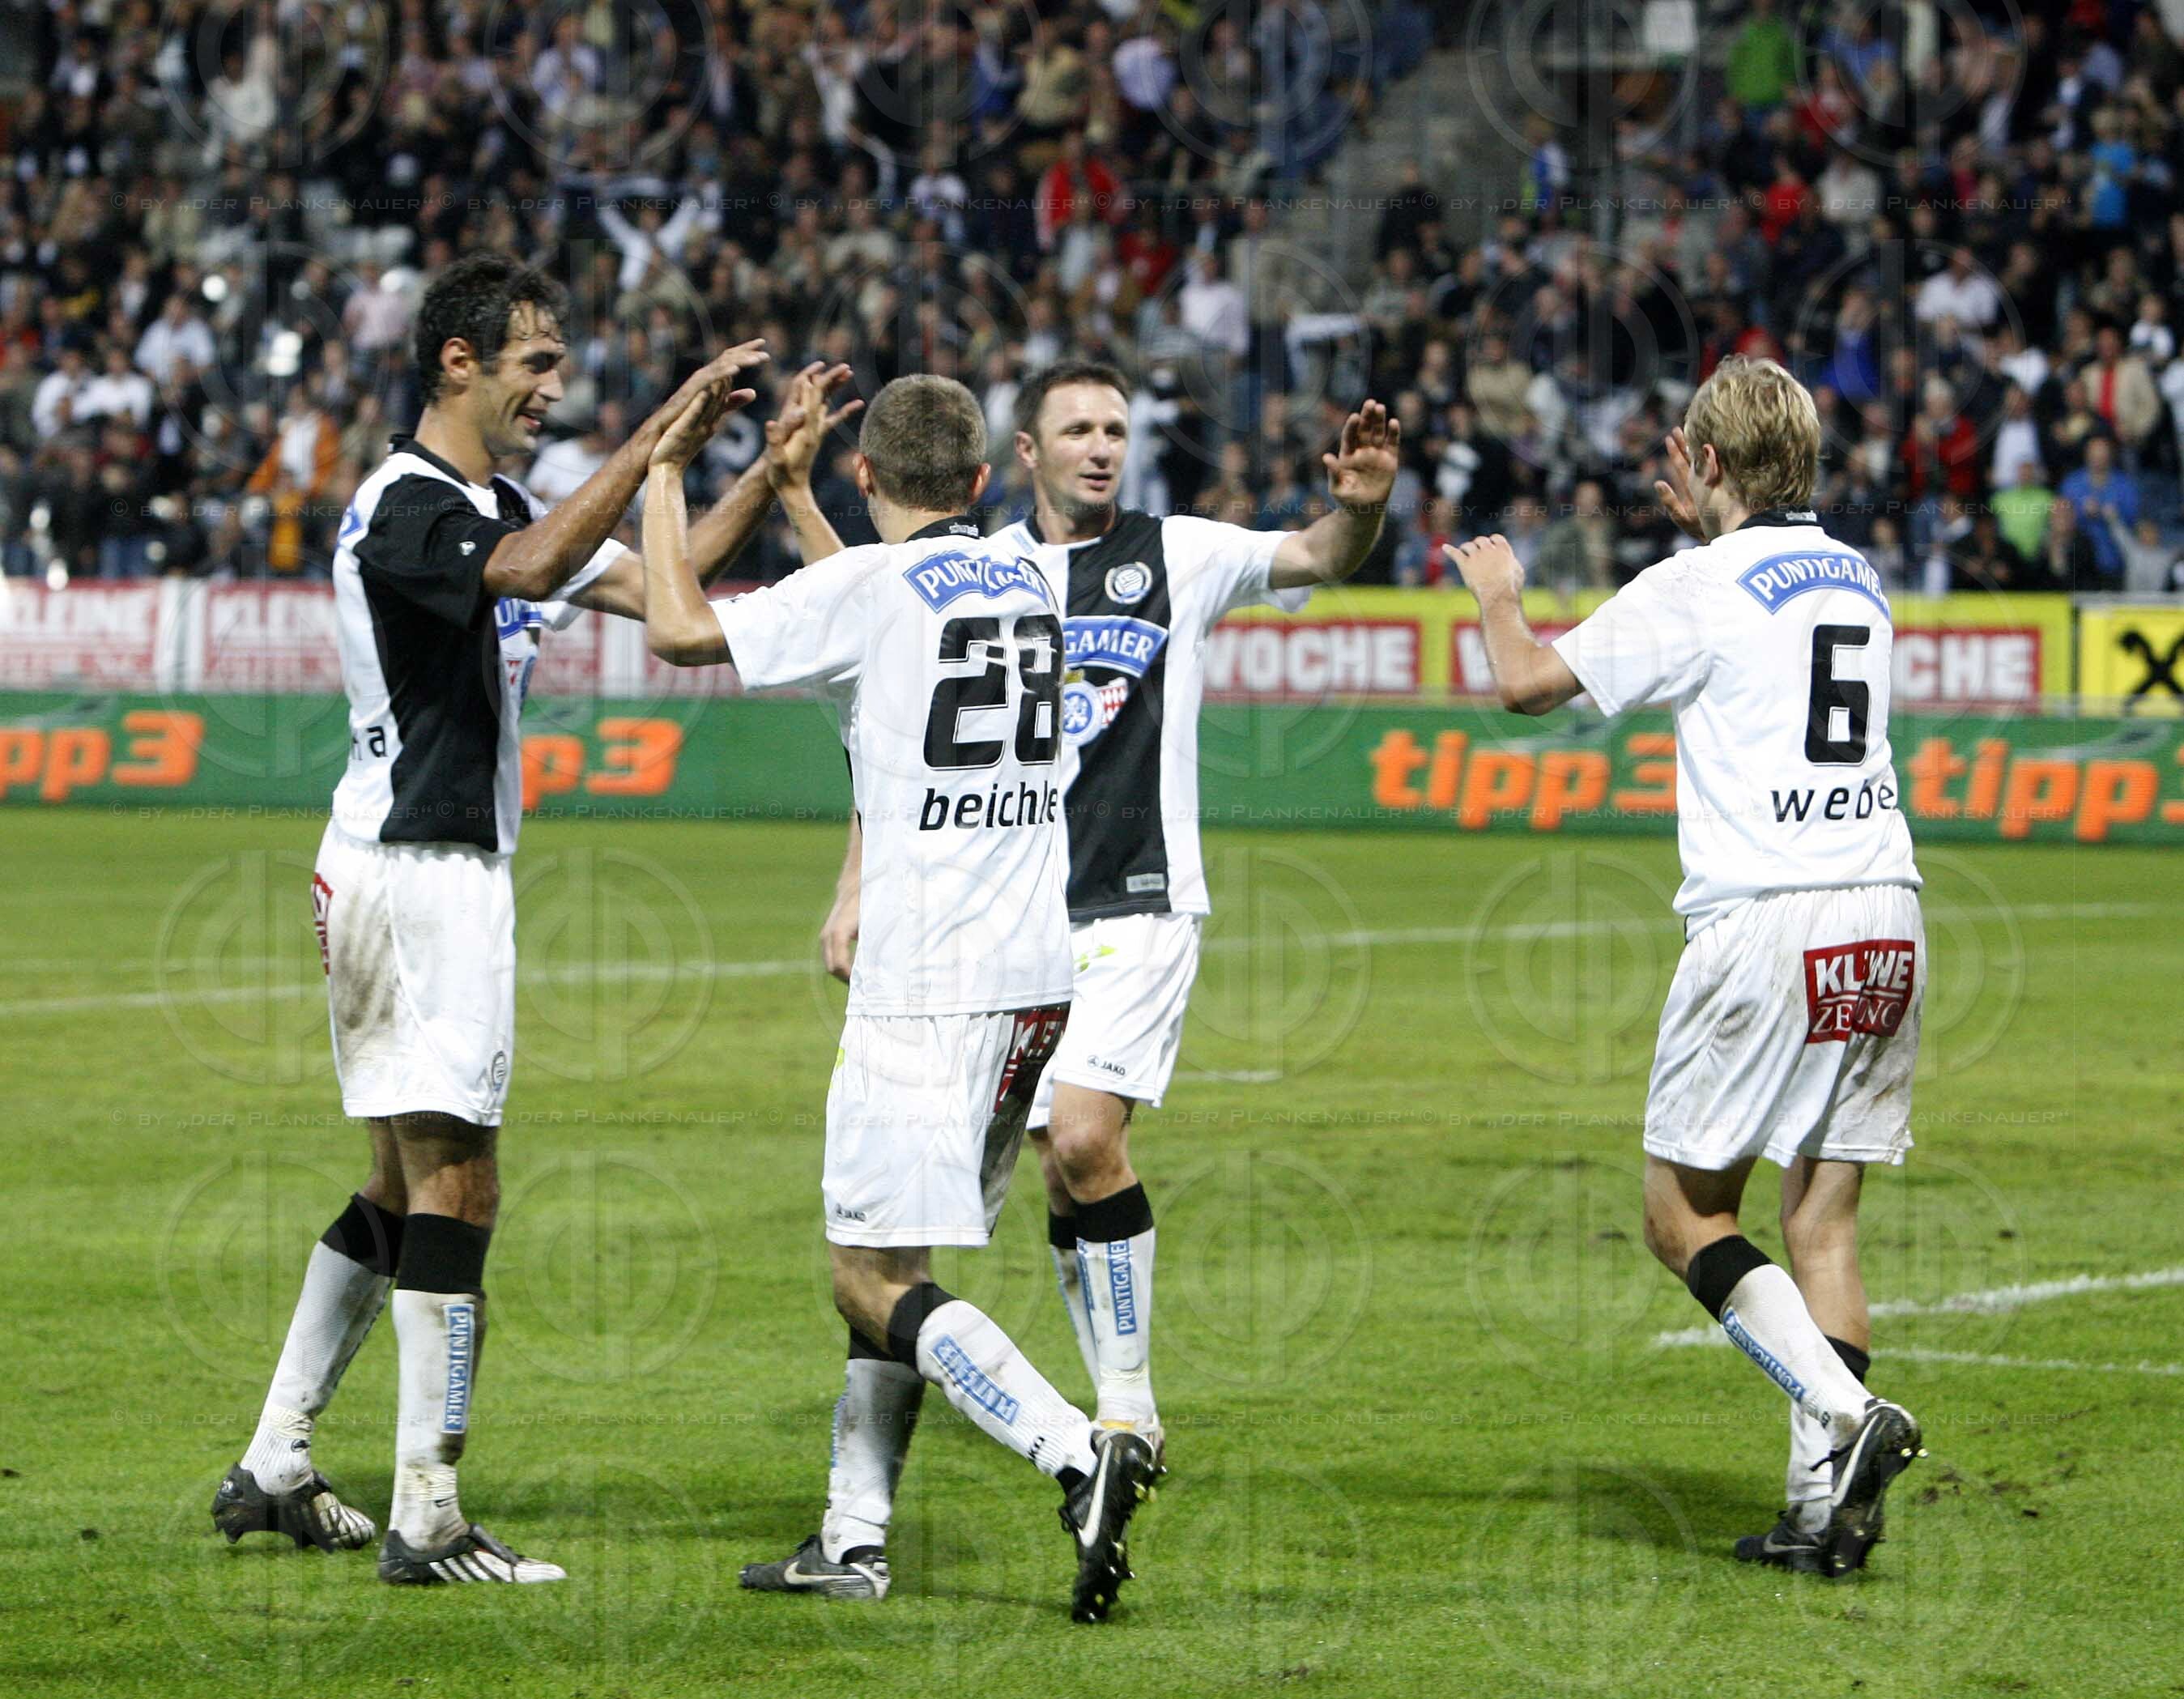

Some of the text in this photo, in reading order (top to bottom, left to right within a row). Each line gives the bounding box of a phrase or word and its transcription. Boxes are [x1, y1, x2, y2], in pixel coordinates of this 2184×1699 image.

[1748, 556, 1888, 608] PUNTIGAME
[1064, 628, 1155, 662] GAMER
[1204, 625, 1413, 692] WOCHE
[1892, 632, 2036, 701] CHE
[923, 614, 1063, 771] 28
[1804, 624, 1871, 766] 6
[0, 710, 205, 802] pp3
[1369, 730, 1676, 829] tipp3
[1906, 737, 2184, 841] tipp
[918, 780, 1058, 831] beichle
[1769, 779, 1897, 823] webe
[1109, 1241, 1135, 1332] PUNTIGAME
